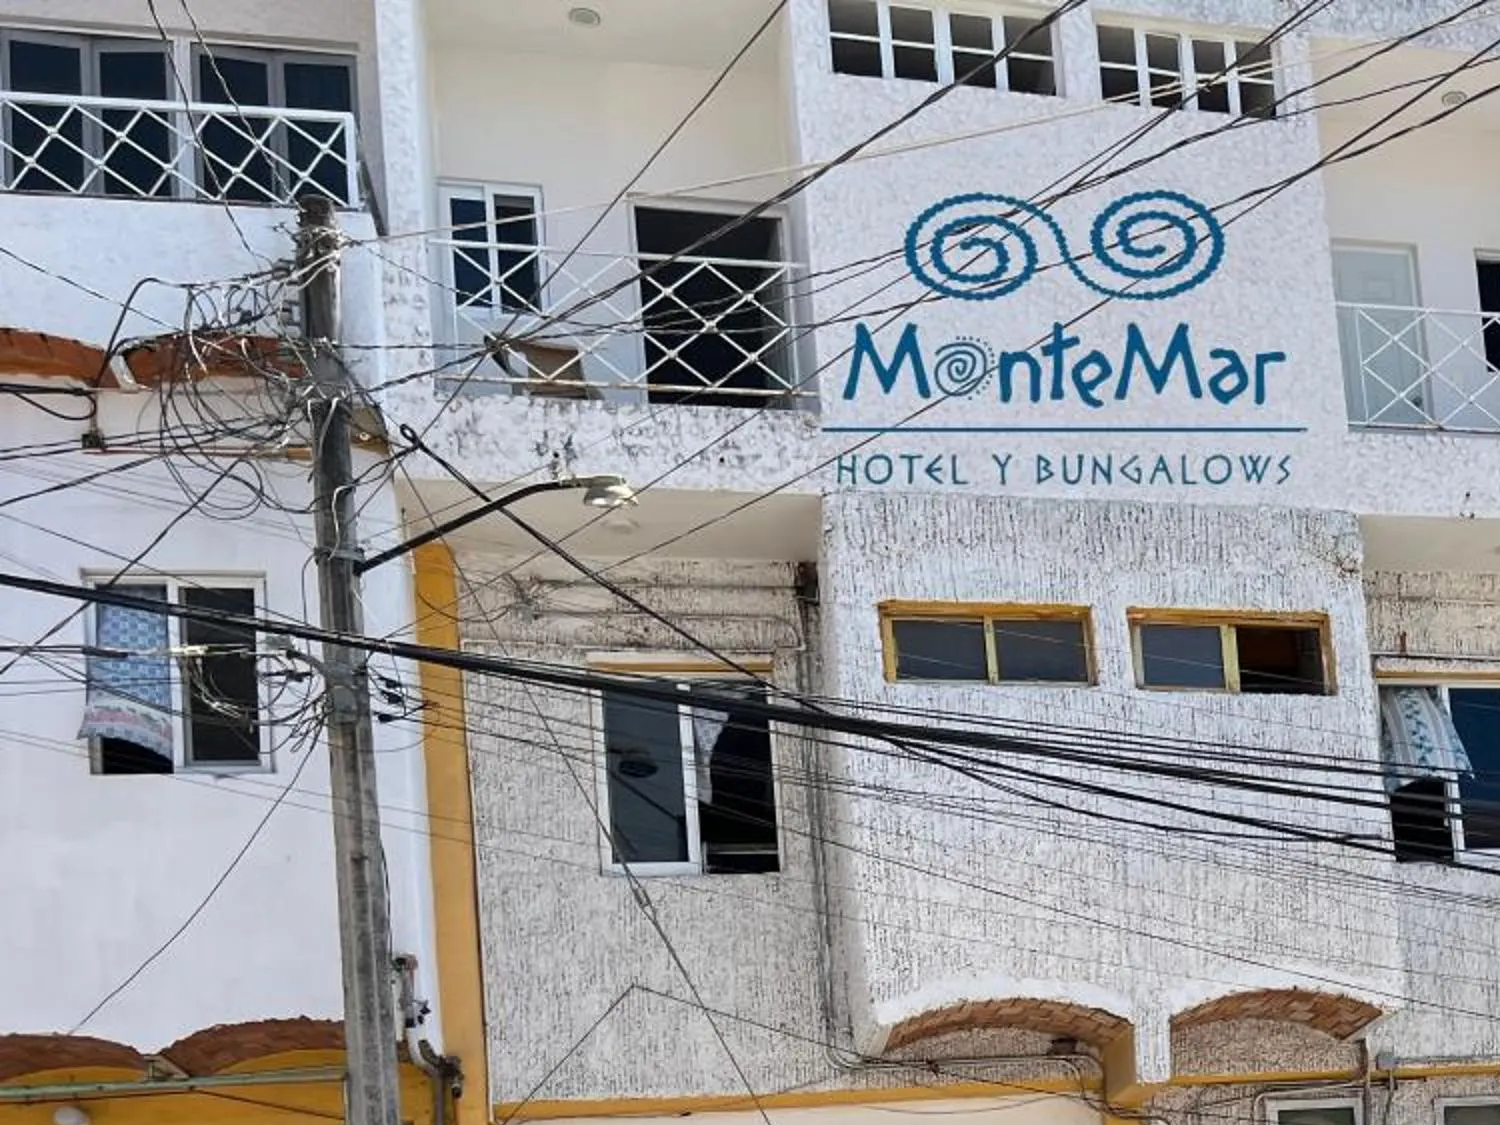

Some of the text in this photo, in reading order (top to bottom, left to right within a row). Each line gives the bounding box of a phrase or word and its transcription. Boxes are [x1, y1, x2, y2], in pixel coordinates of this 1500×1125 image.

[843, 322, 1286, 407] MonteMar
[837, 453, 1292, 485] HOTEL Y BUNGALOWS
